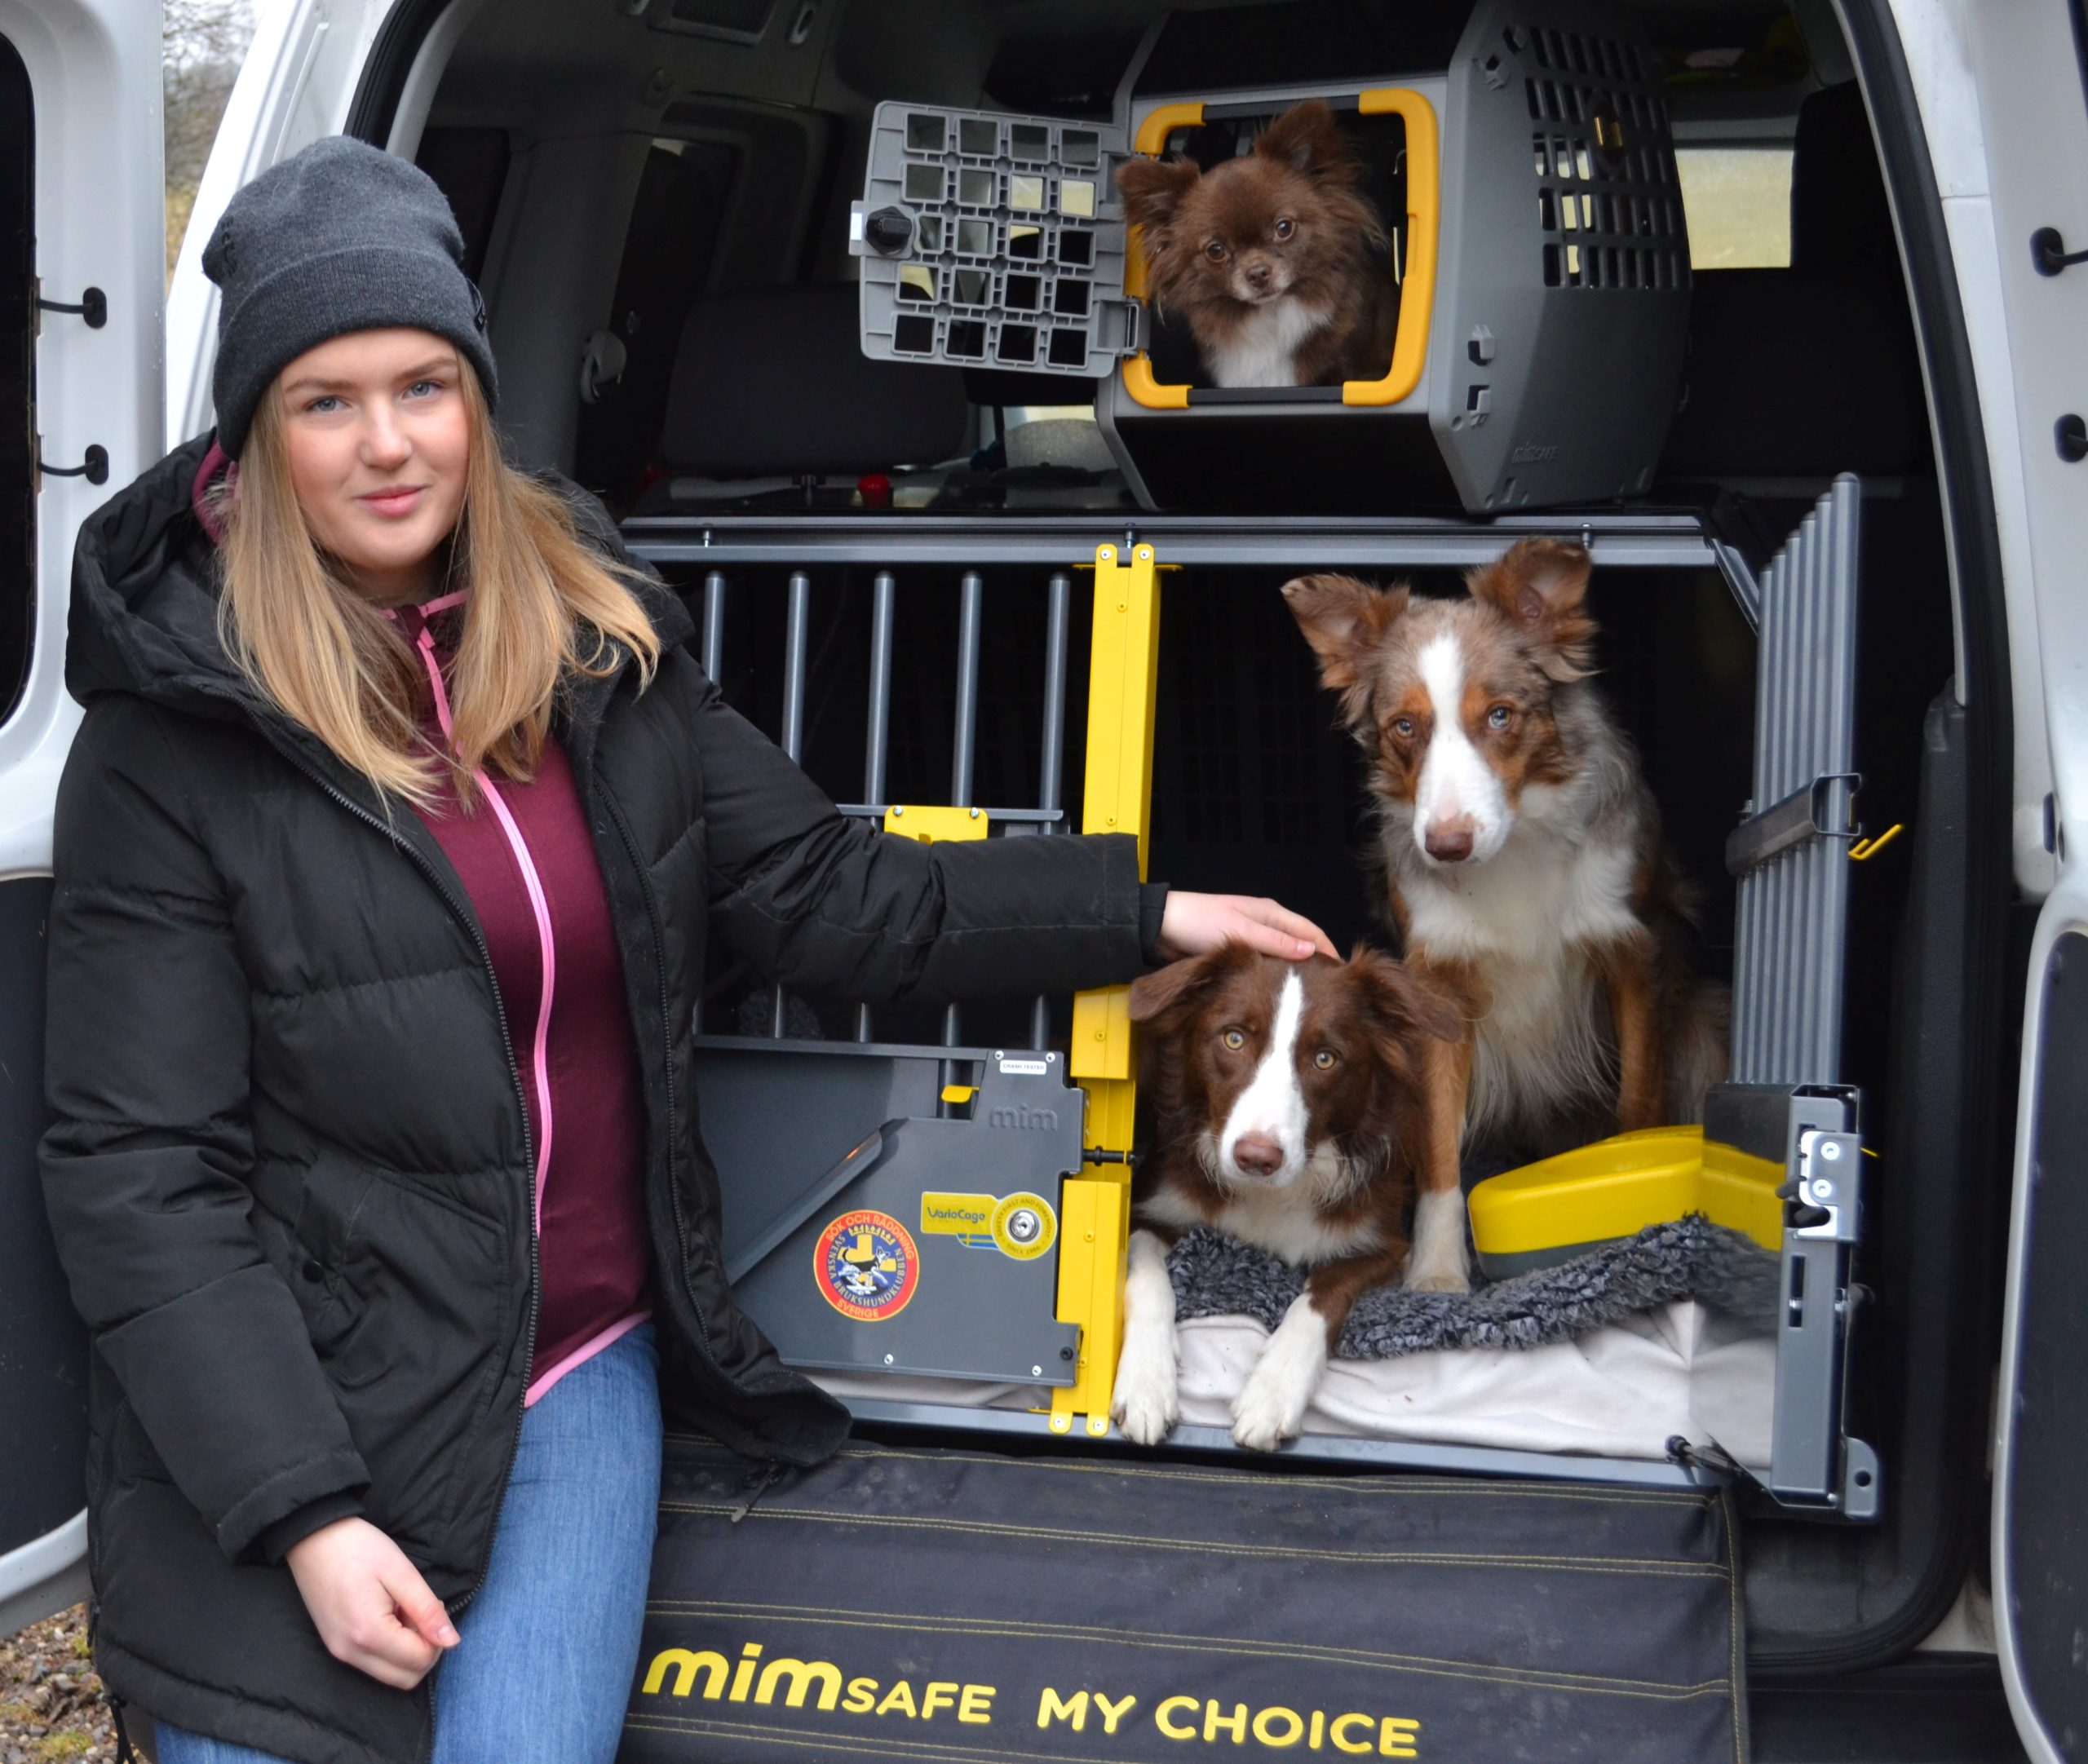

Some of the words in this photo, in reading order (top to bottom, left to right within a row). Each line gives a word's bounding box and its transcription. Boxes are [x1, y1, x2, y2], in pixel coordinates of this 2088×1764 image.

[989, 1102, 1058, 1131] mim
[927, 1206, 986, 1224] VarioCage
[1002, 1198, 1019, 1212] FIRST
[845, 1214, 870, 1226] OCH
[828, 1235, 846, 1280] SVENSKA
[834, 1248, 906, 1307] BRUKSHUNDKLUBBEN
[837, 1298, 880, 1319] SVERIGE
[642, 1641, 996, 1724] mimSAFE
[1037, 1687, 1137, 1734] MY
[1154, 1695, 1422, 1759] CHOICE
